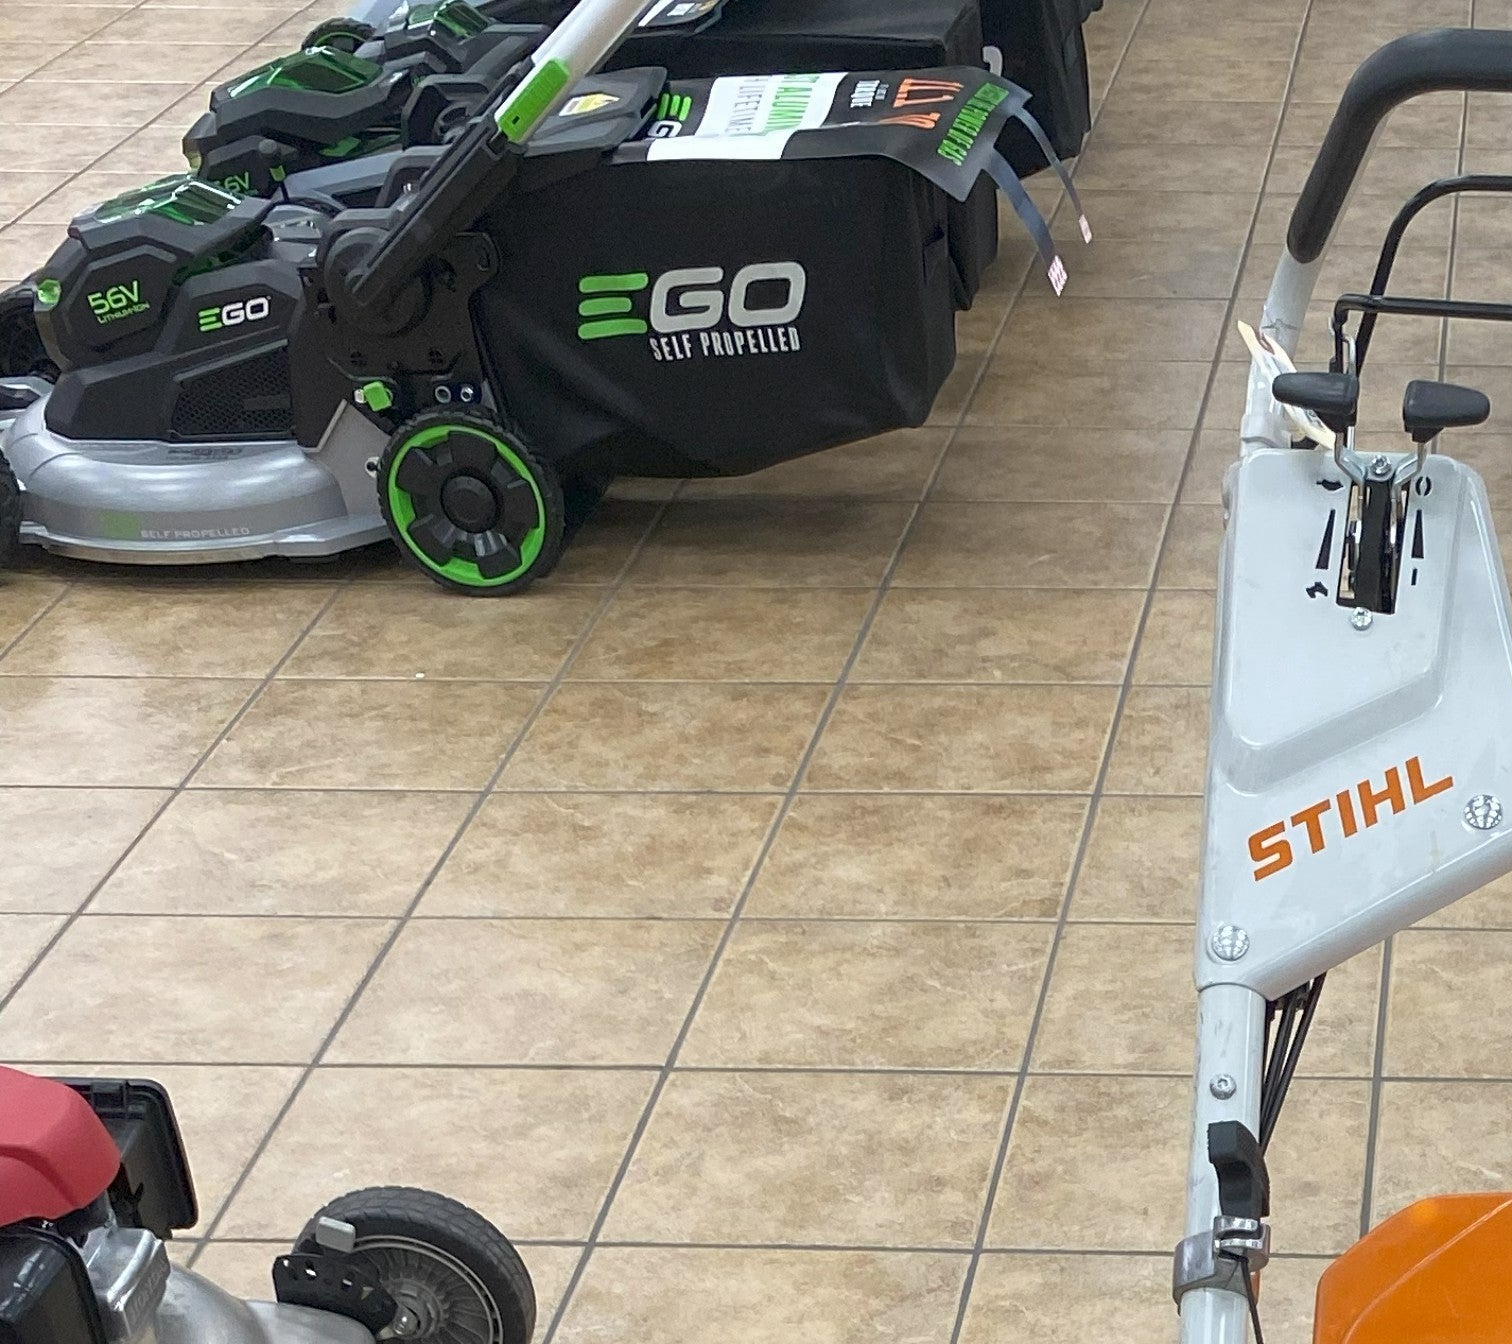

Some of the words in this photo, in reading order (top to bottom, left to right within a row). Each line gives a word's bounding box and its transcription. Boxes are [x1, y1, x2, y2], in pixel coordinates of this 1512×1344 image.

[648, 93, 692, 138] EG
[88, 280, 140, 315] 56V
[198, 296, 270, 332] EGO
[577, 261, 807, 340] EGO
[649, 333, 694, 362] SELF
[700, 326, 801, 357] PROPELLED
[1248, 756, 1453, 881] STIHL
